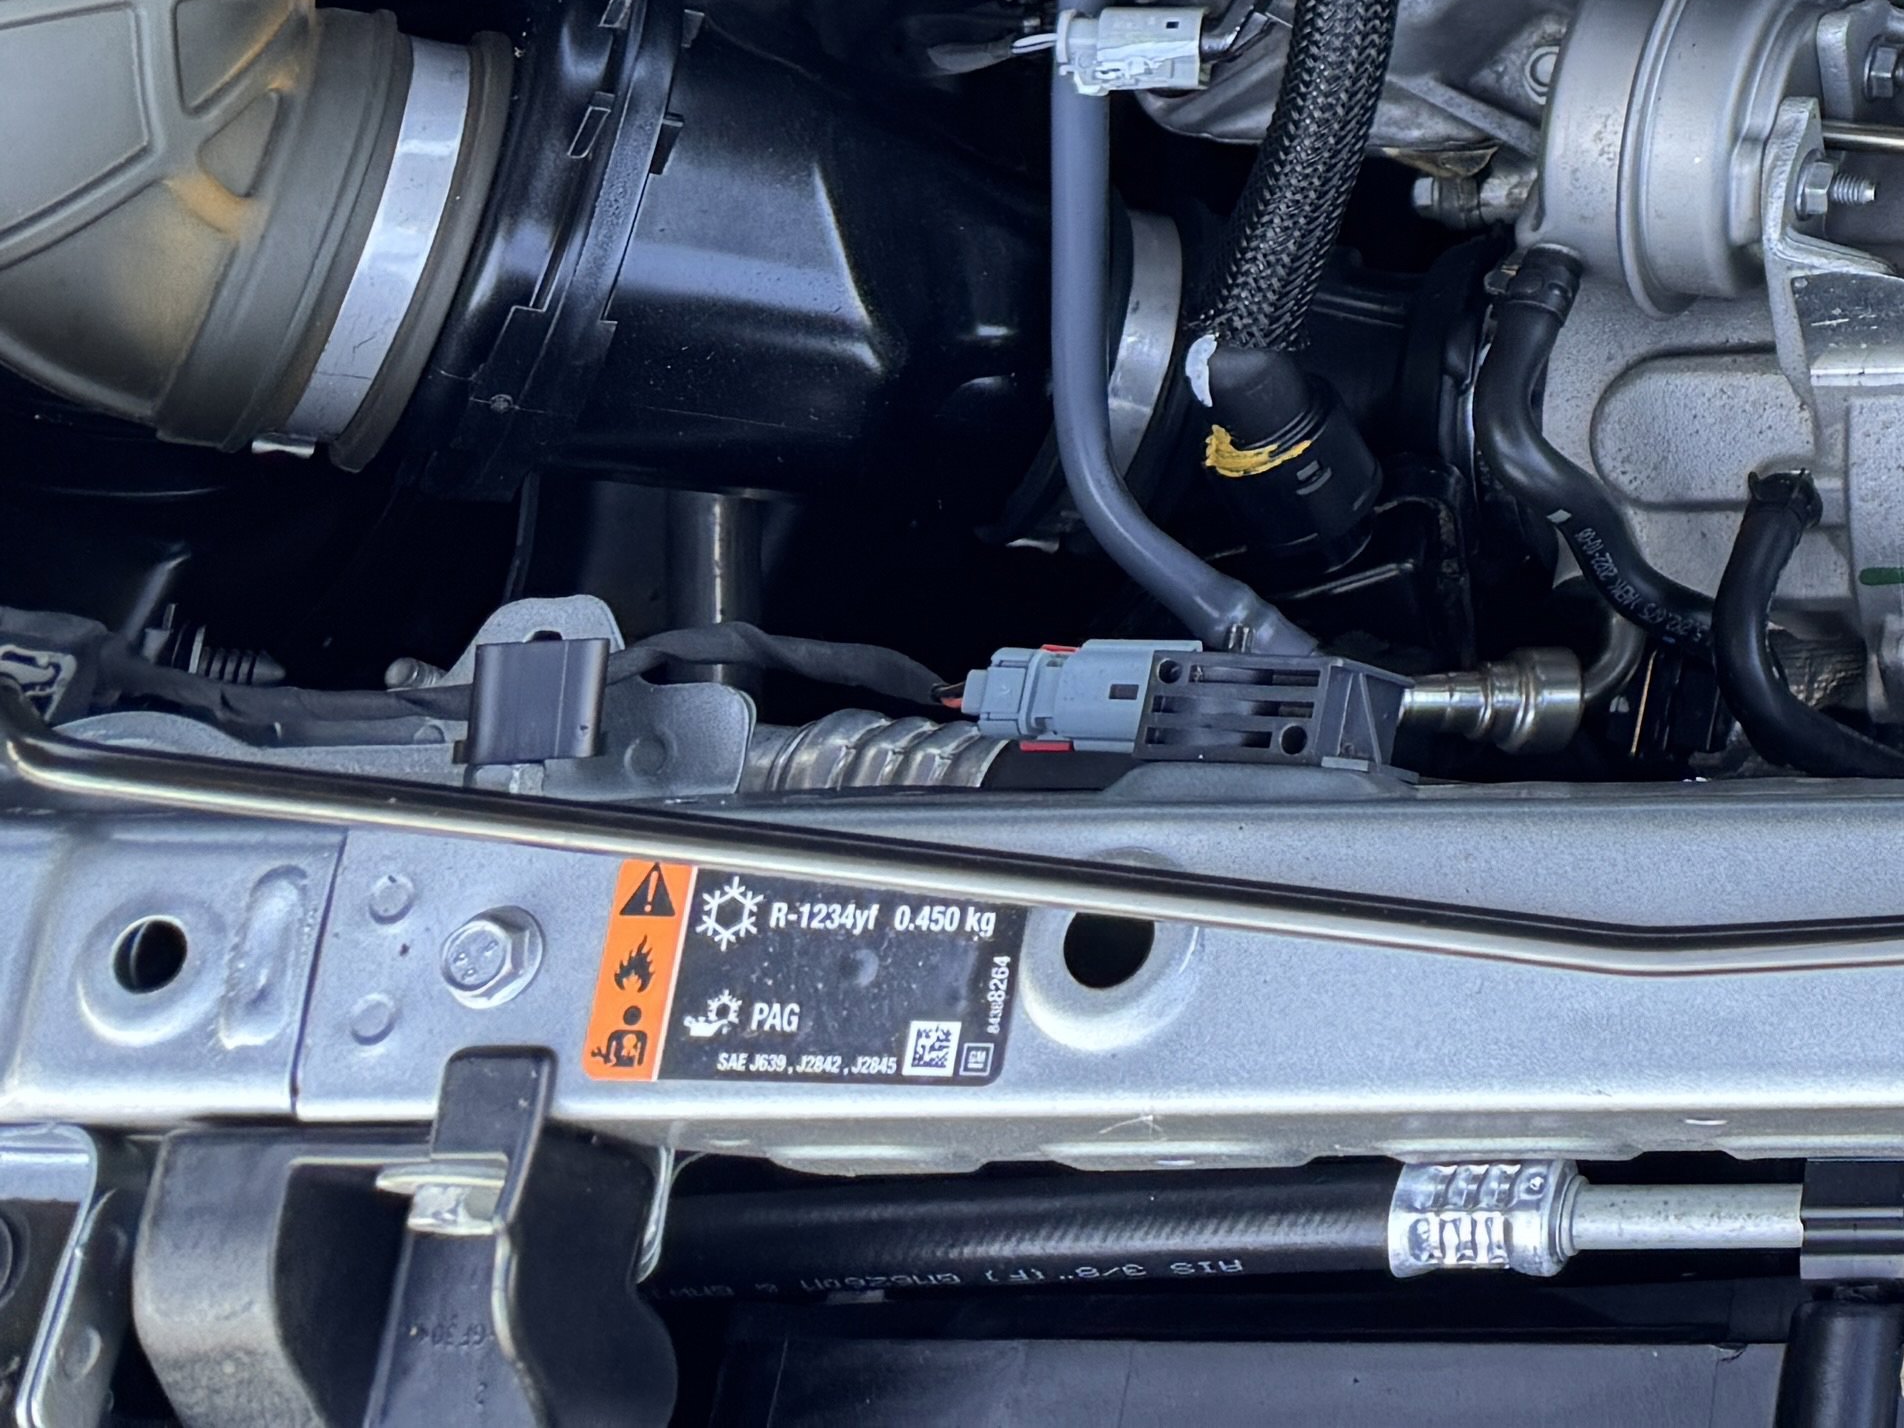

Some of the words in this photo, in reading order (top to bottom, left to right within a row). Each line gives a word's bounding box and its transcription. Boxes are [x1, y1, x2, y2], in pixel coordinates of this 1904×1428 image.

[769, 901, 880, 936] R-1234yf
[894, 905, 961, 932] 0.450
[965, 907, 997, 937] kg
[750, 1002, 800, 1032] PAG
[717, 1052, 747, 1071] SAE
[851, 1056, 897, 1075] J2845
[967, 1050, 986, 1063] GM
